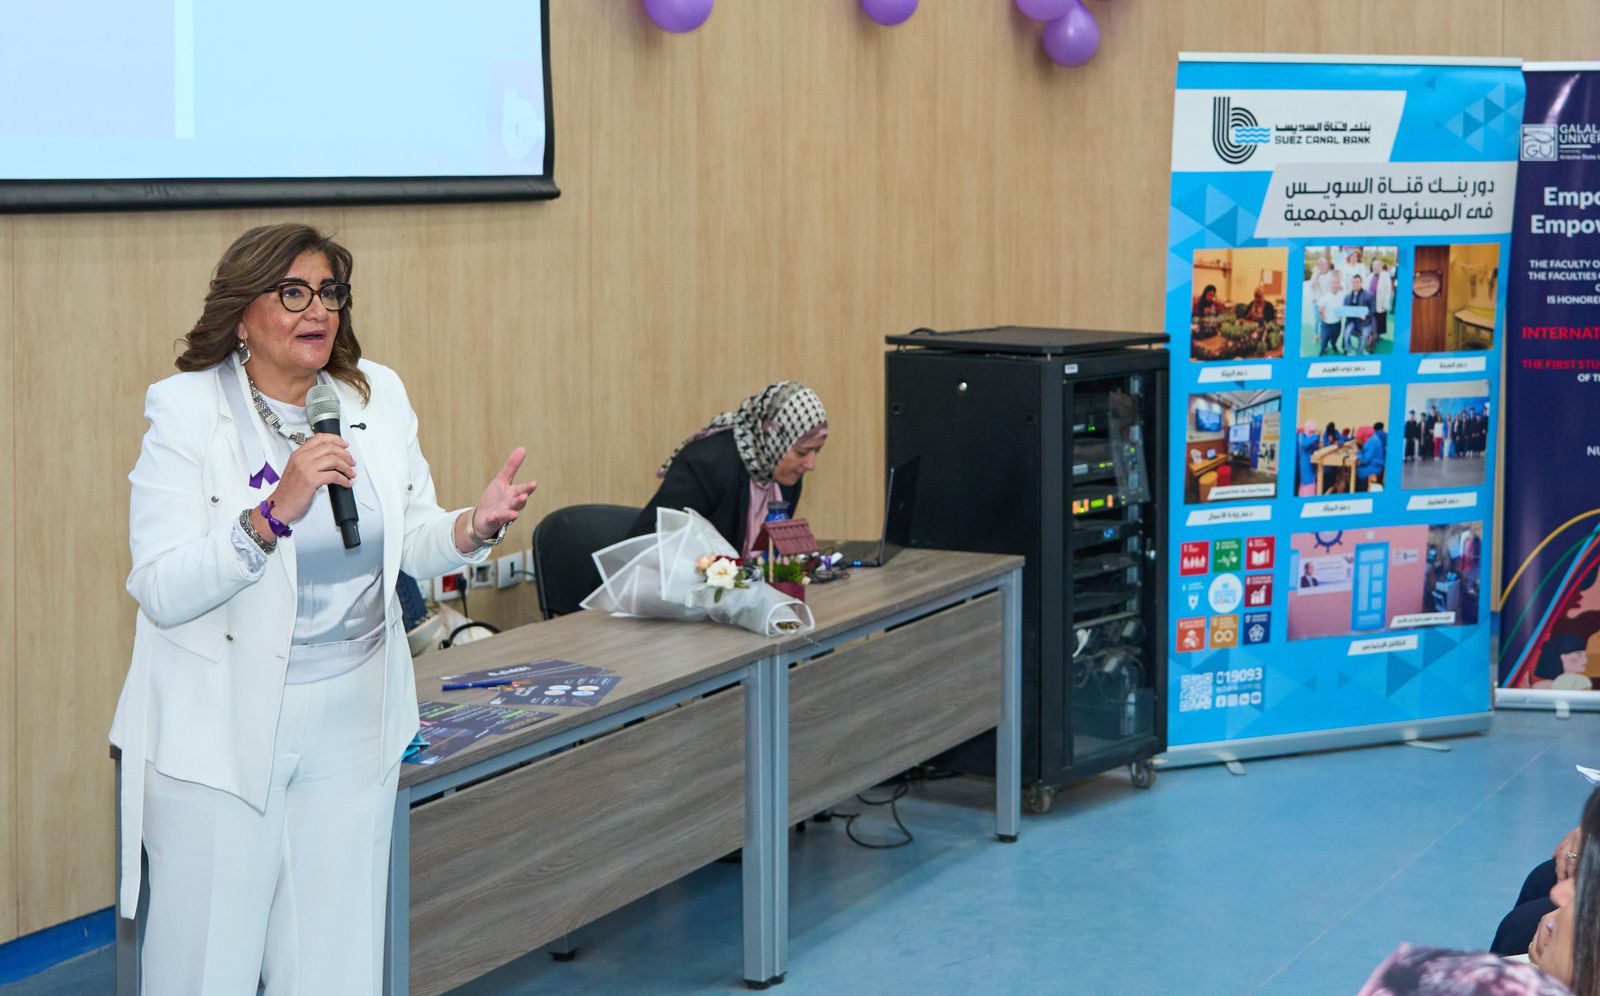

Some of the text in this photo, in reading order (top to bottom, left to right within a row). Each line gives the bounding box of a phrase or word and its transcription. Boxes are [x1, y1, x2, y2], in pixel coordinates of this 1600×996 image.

[1559, 123, 1600, 134] GALAL
[1275, 135, 1371, 144] SUEZ CANAL BANK
[1285, 175, 1494, 199] دور بنك قناة السويس
[1284, 203, 1374, 226] المجتمعية
[1378, 201, 1462, 226] المسئولية
[1529, 259, 1549, 269] THE
[1549, 259, 1591, 269] FACULTY
[1528, 271, 1547, 280] THE
[1547, 271, 1597, 281] FACULTIES
[1546, 295, 1556, 304] IS
[1521, 326, 1600, 340] INTERNAT
[1522, 359, 1542, 369] THE
[1545, 359, 1577, 369] FIRST
[1577, 373, 1600, 382] OF T
